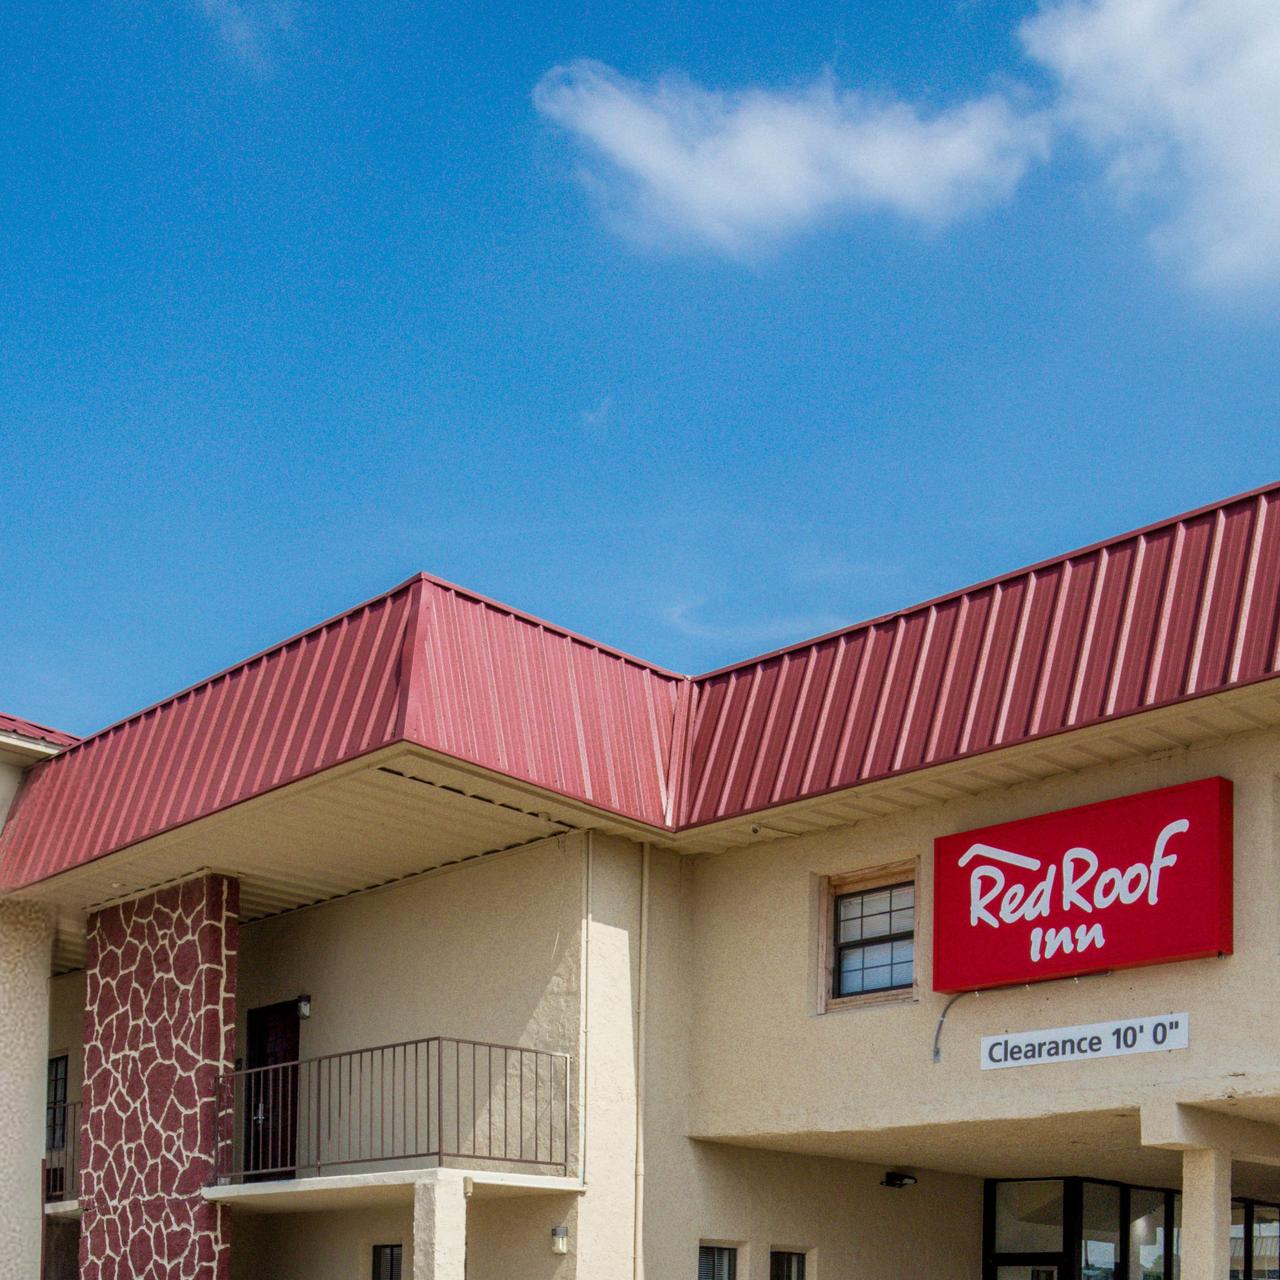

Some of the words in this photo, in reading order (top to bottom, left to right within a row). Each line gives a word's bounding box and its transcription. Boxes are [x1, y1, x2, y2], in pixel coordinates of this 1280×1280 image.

[970, 864, 1057, 929] Red
[1062, 818, 1190, 914] Roof
[988, 1035, 1102, 1063] Clearance
[1111, 1025, 1144, 1049] 10'
[1152, 1021, 1179, 1045] 0"
